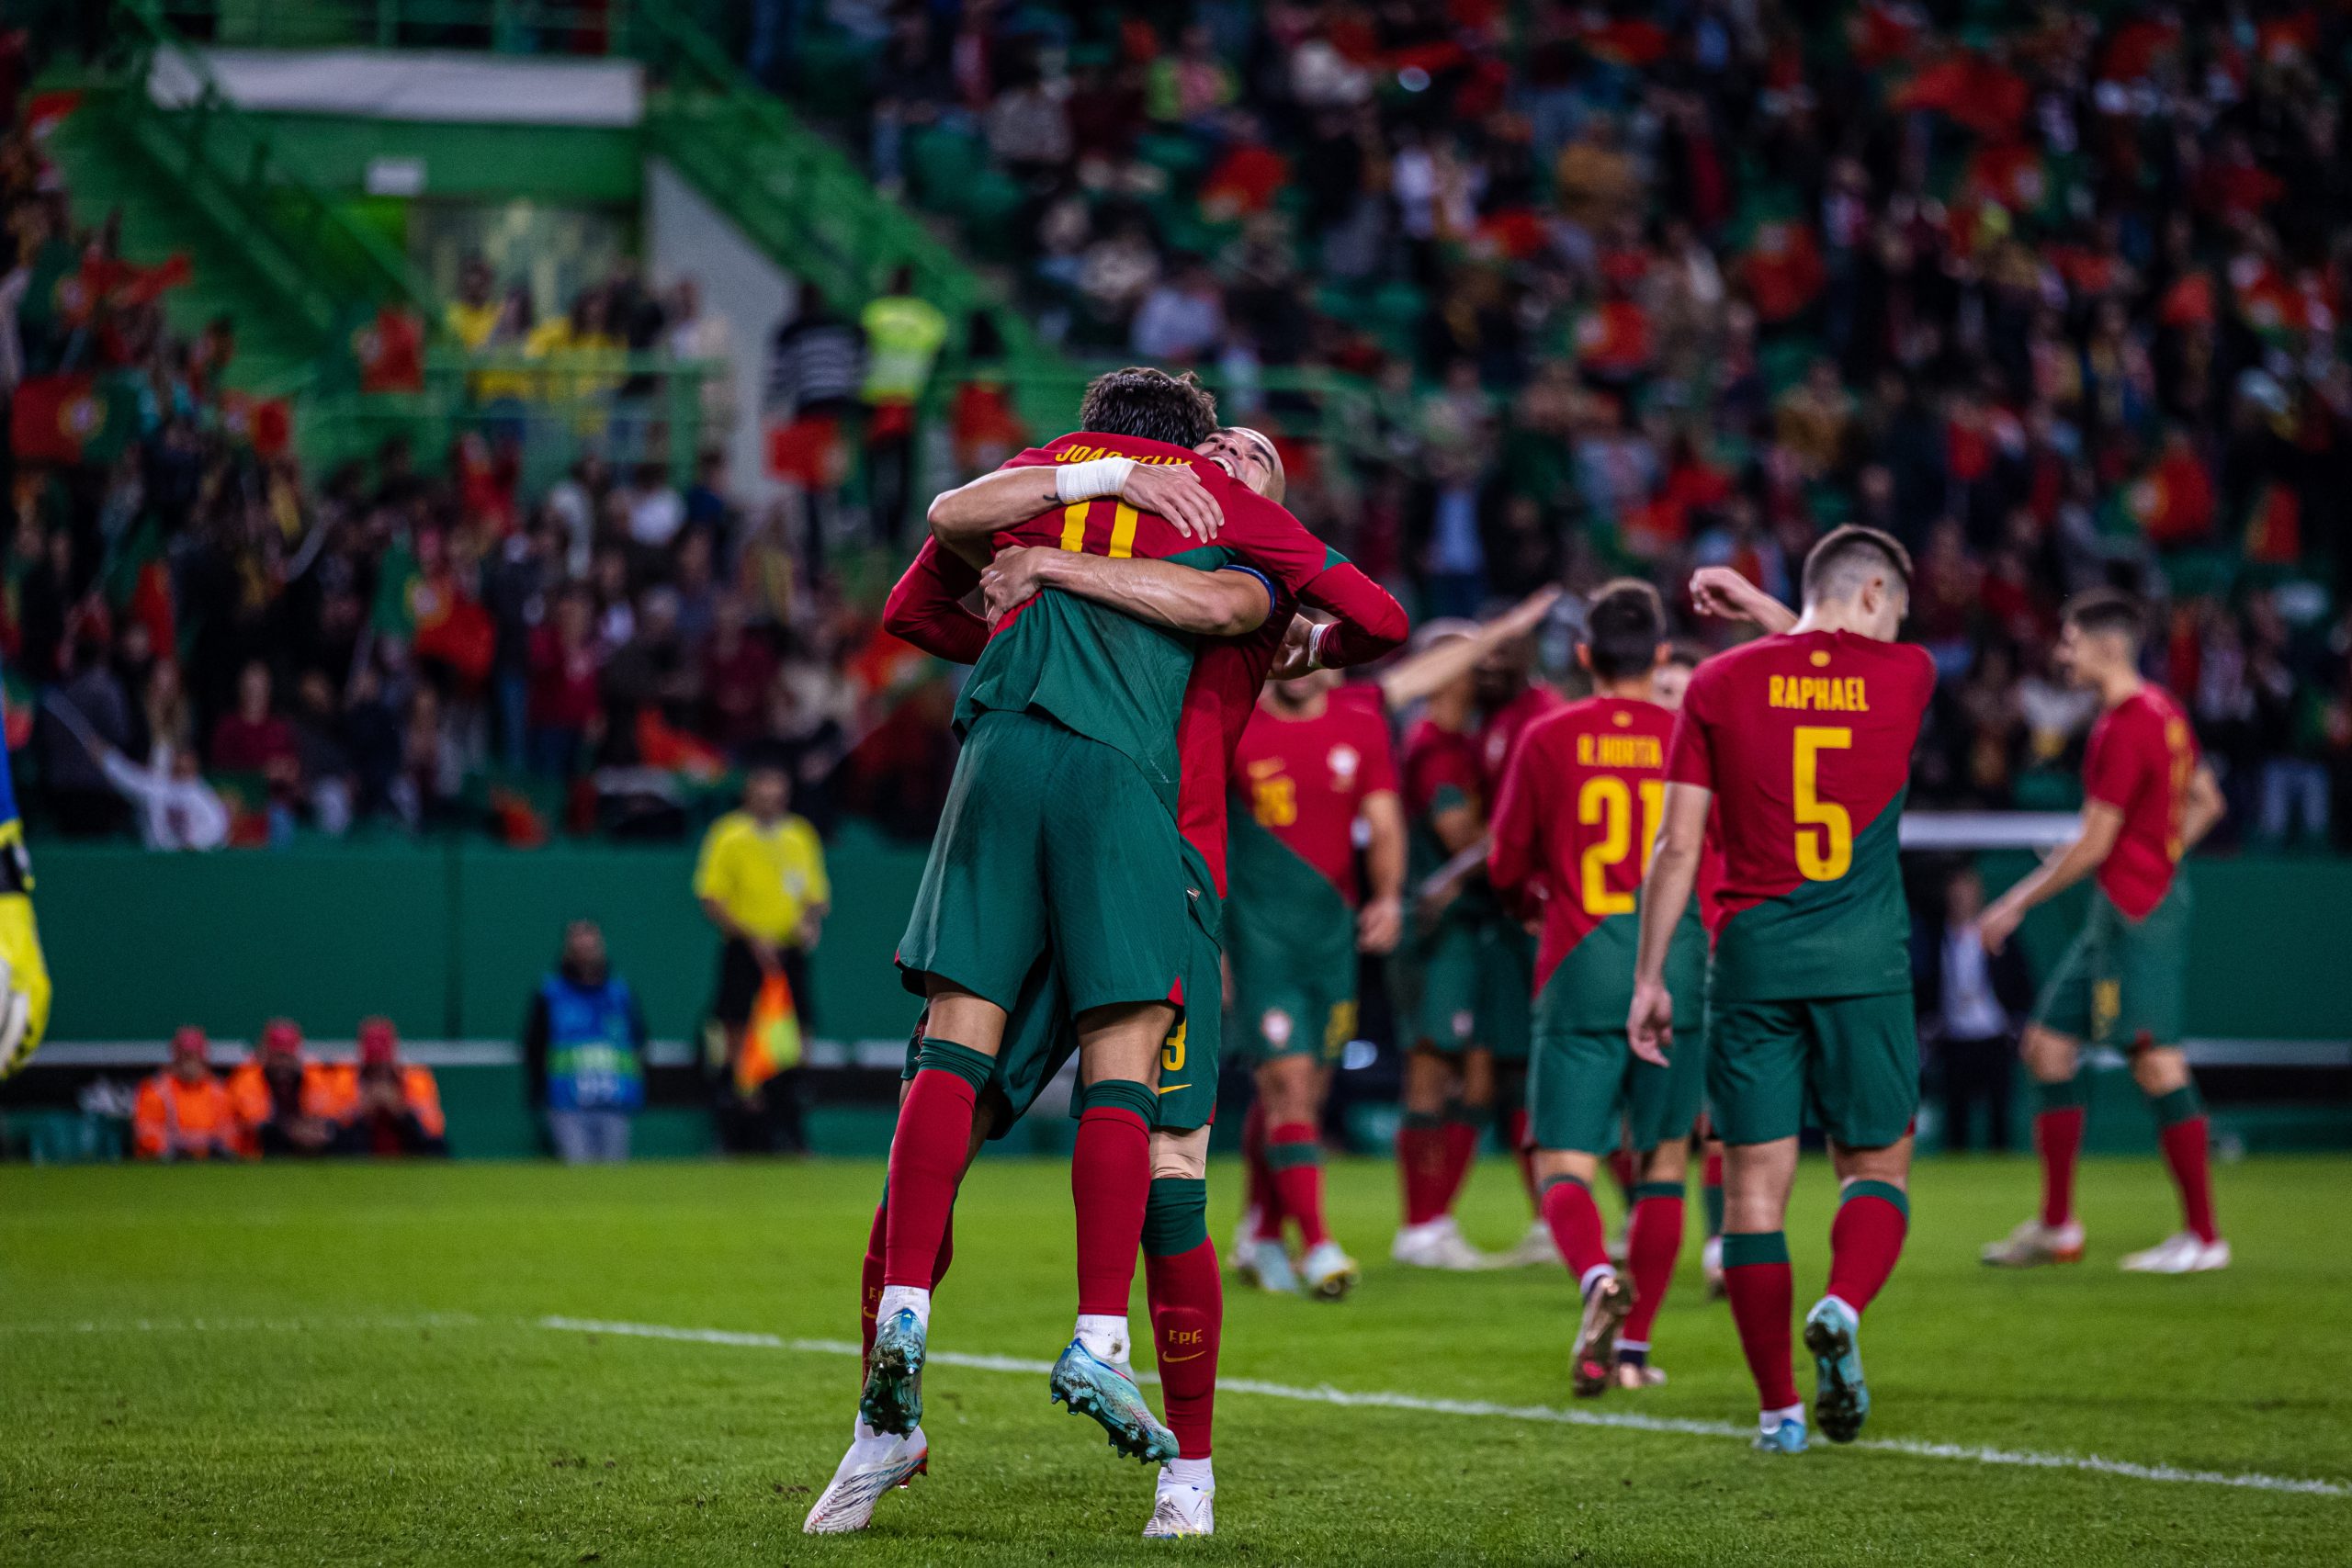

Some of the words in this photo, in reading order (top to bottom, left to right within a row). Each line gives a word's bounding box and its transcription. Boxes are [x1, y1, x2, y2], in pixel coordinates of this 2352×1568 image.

[1769, 674, 1871, 712] RAPHAEL
[1577, 774, 1666, 914] 21
[1793, 725, 1853, 882] 5
